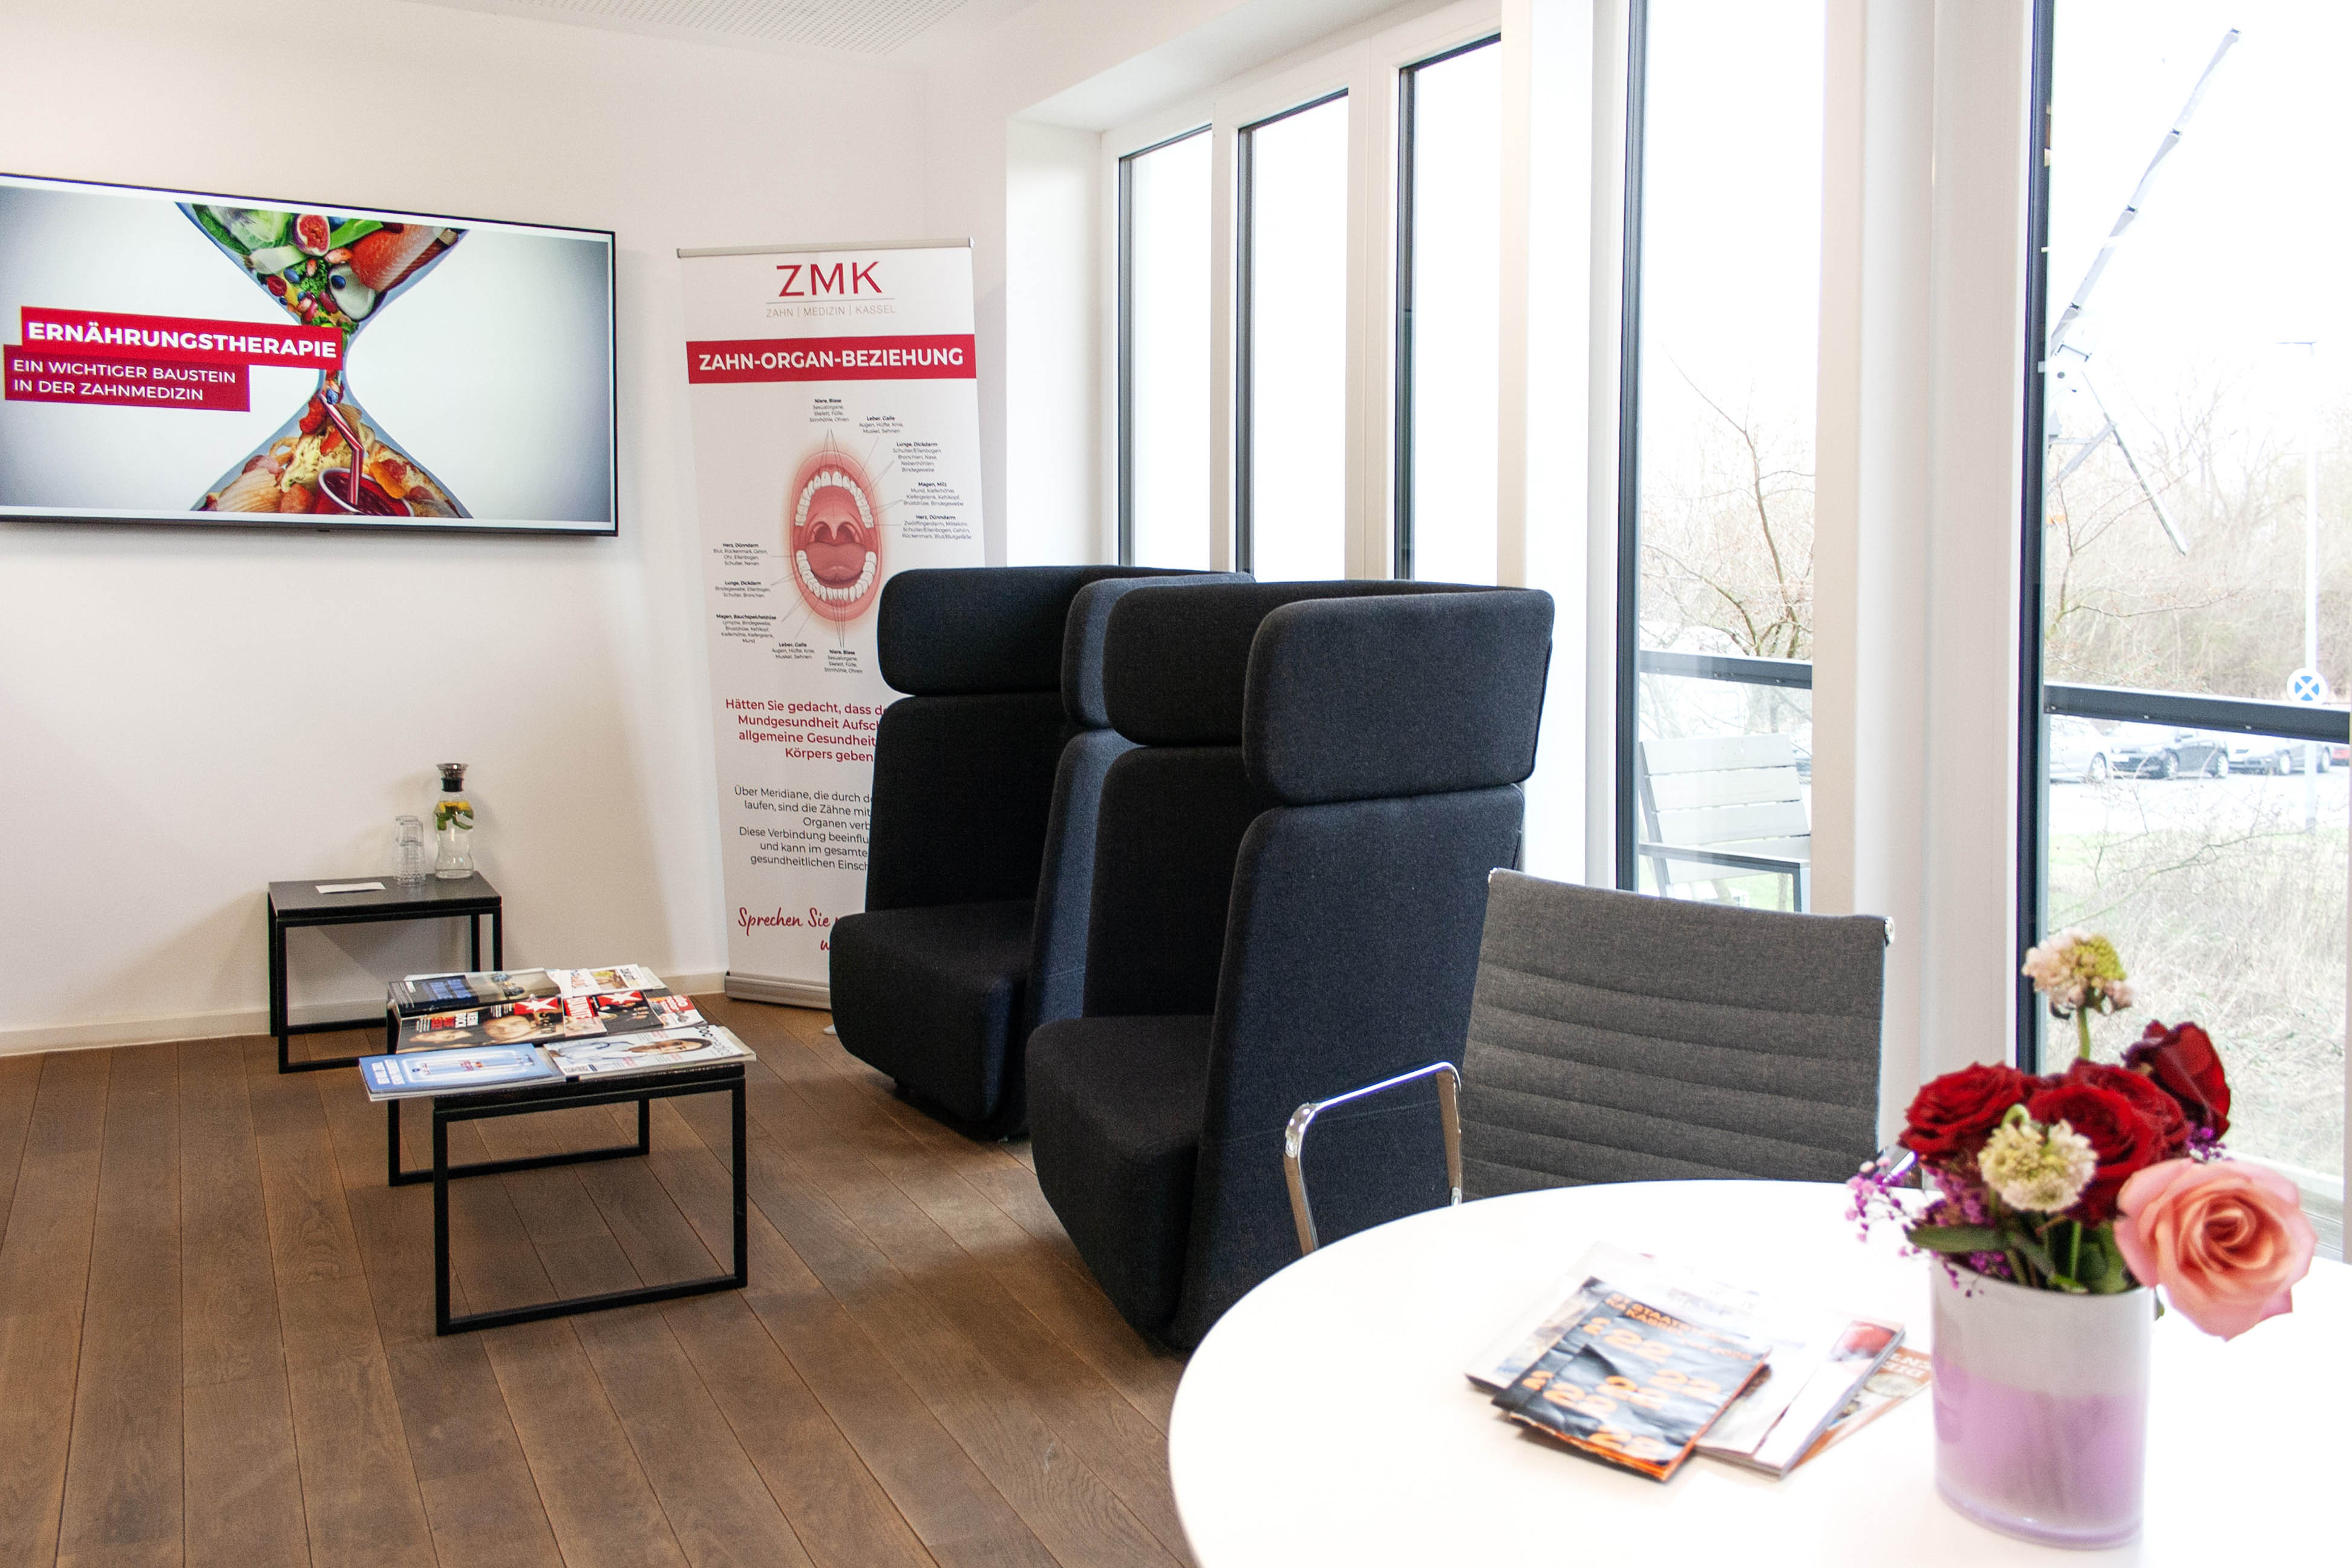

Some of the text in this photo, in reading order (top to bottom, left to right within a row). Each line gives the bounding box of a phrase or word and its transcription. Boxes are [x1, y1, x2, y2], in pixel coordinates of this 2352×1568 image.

[777, 261, 882, 297] ZMK
[766, 304, 896, 318] ZAHN MEDIZIN KASSEL
[28, 321, 336, 358] ERNÄHRUNGSTHERAPIE
[699, 348, 964, 371] ZAHN-ORGAN-BEZIEHUNG
[14, 359, 235, 384] EIN WICHTIGER BAUSTEIN
[15, 379, 203, 401] IN DER ZAHNMEDIZIN
[726, 698, 765, 711] Hätten
[768, 700, 784, 711] Sie
[788, 701, 841, 715] gedacht,
[844, 703, 871, 714] dass
[738, 714, 839, 729] Mundgesundheit
[739, 730, 876, 746] allgemeine Gesundheit
[785, 747, 874, 762] Körpers geben
[734, 785, 872, 803] Über Meridiane, die durch d
[745, 800, 871, 817] laufen, sind die Zähne mit
[803, 817, 847, 829] Organen
[739, 826, 765, 837] Diese
[768, 828, 826, 842] Verbindung
[760, 841, 867, 857] und kann im gesamte
[751, 855, 835, 869] gesundheitlichen
[738, 907, 831, 936] Sprechen Sie
